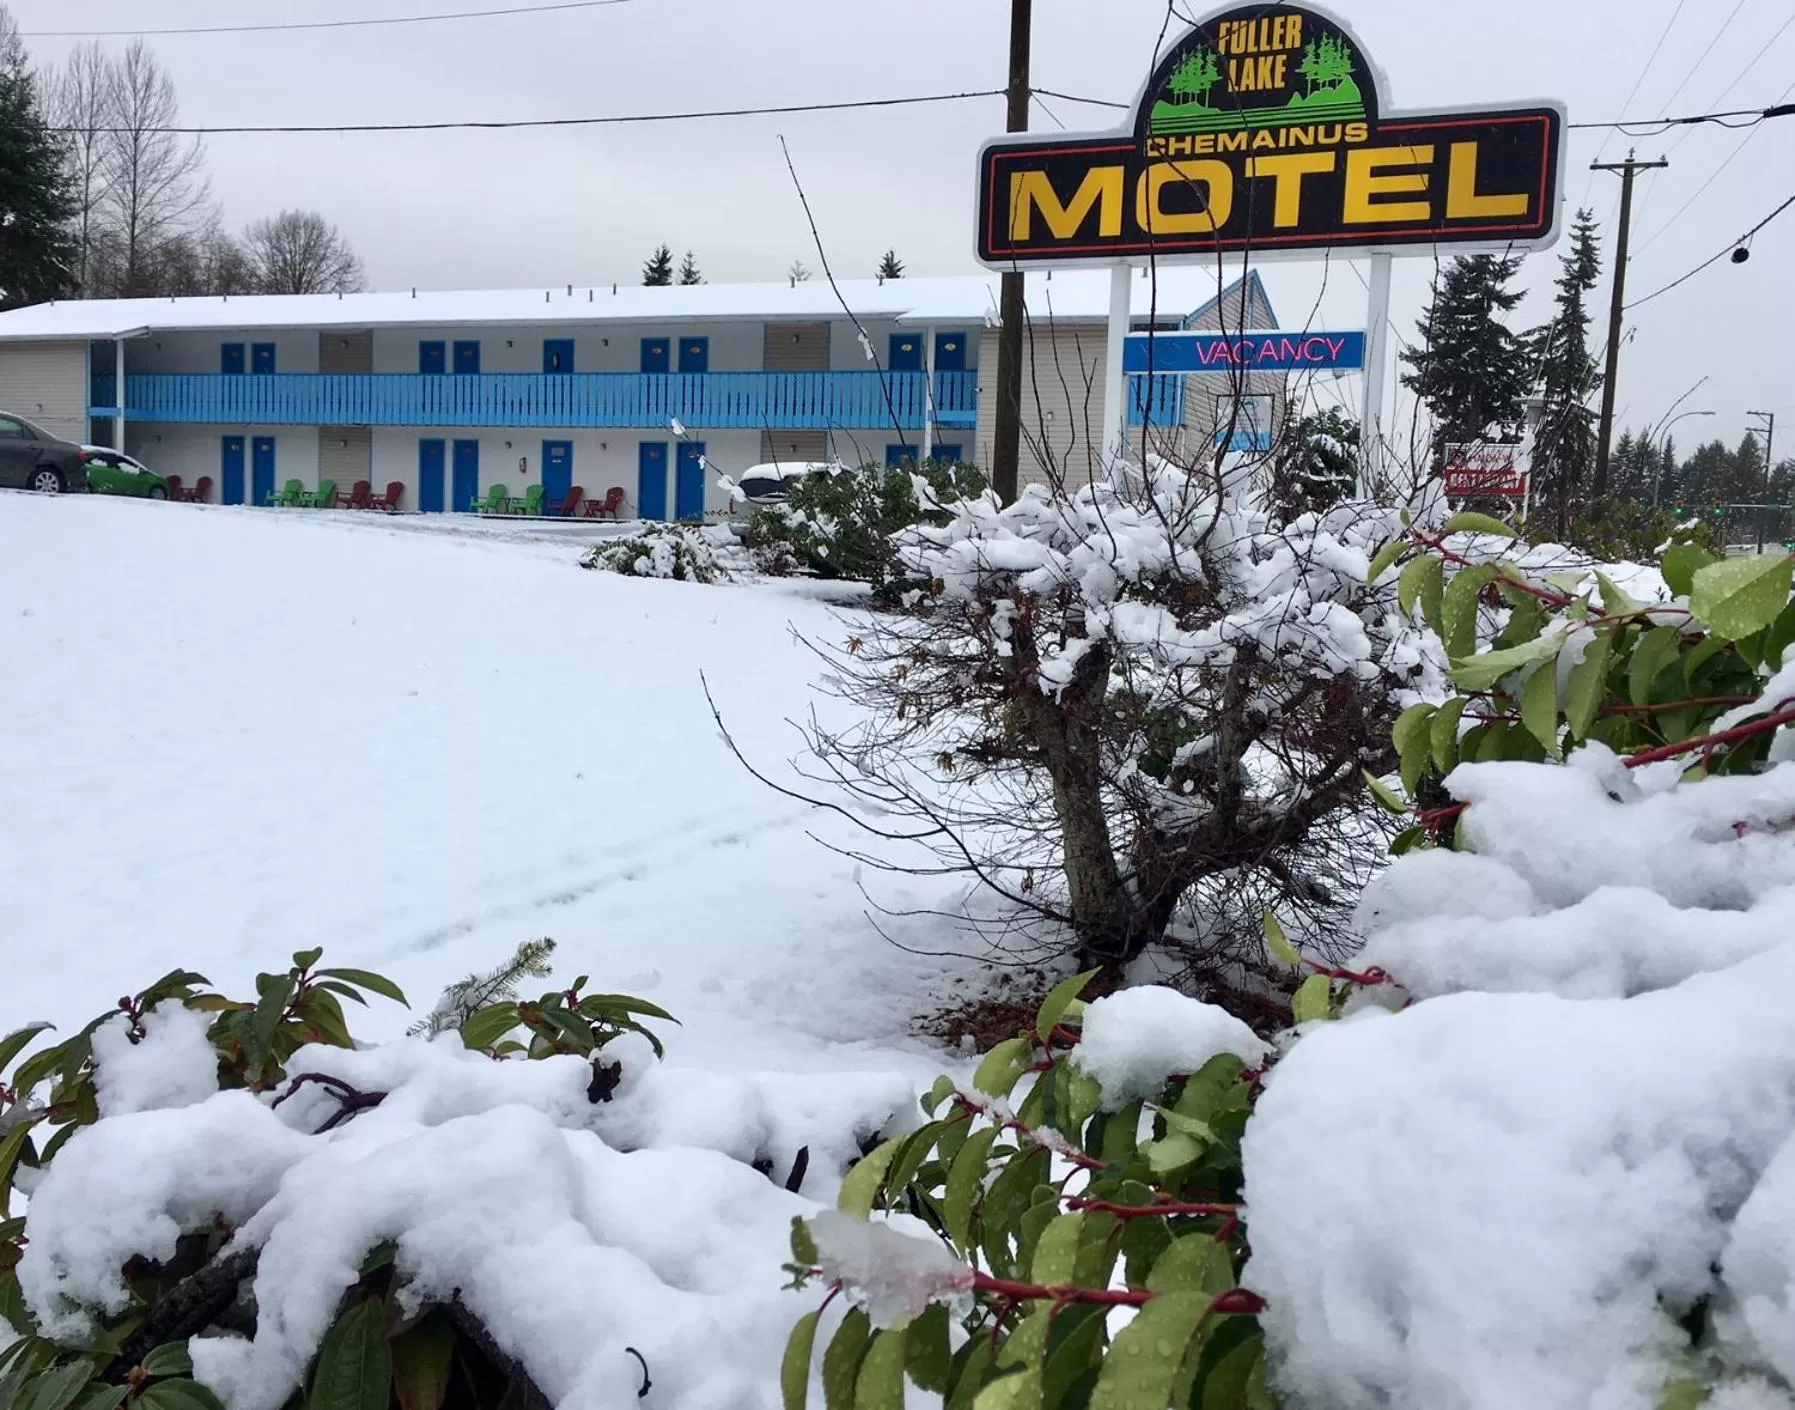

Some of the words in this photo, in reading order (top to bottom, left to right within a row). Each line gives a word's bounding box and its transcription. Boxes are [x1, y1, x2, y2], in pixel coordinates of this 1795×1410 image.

[1219, 14, 1302, 55] FULLER
[1227, 55, 1287, 92] LAKE
[1145, 122, 1368, 157] CHEMAINUS
[1009, 142, 1529, 241] MOTEL
[1196, 337, 1345, 365] VACANCY
